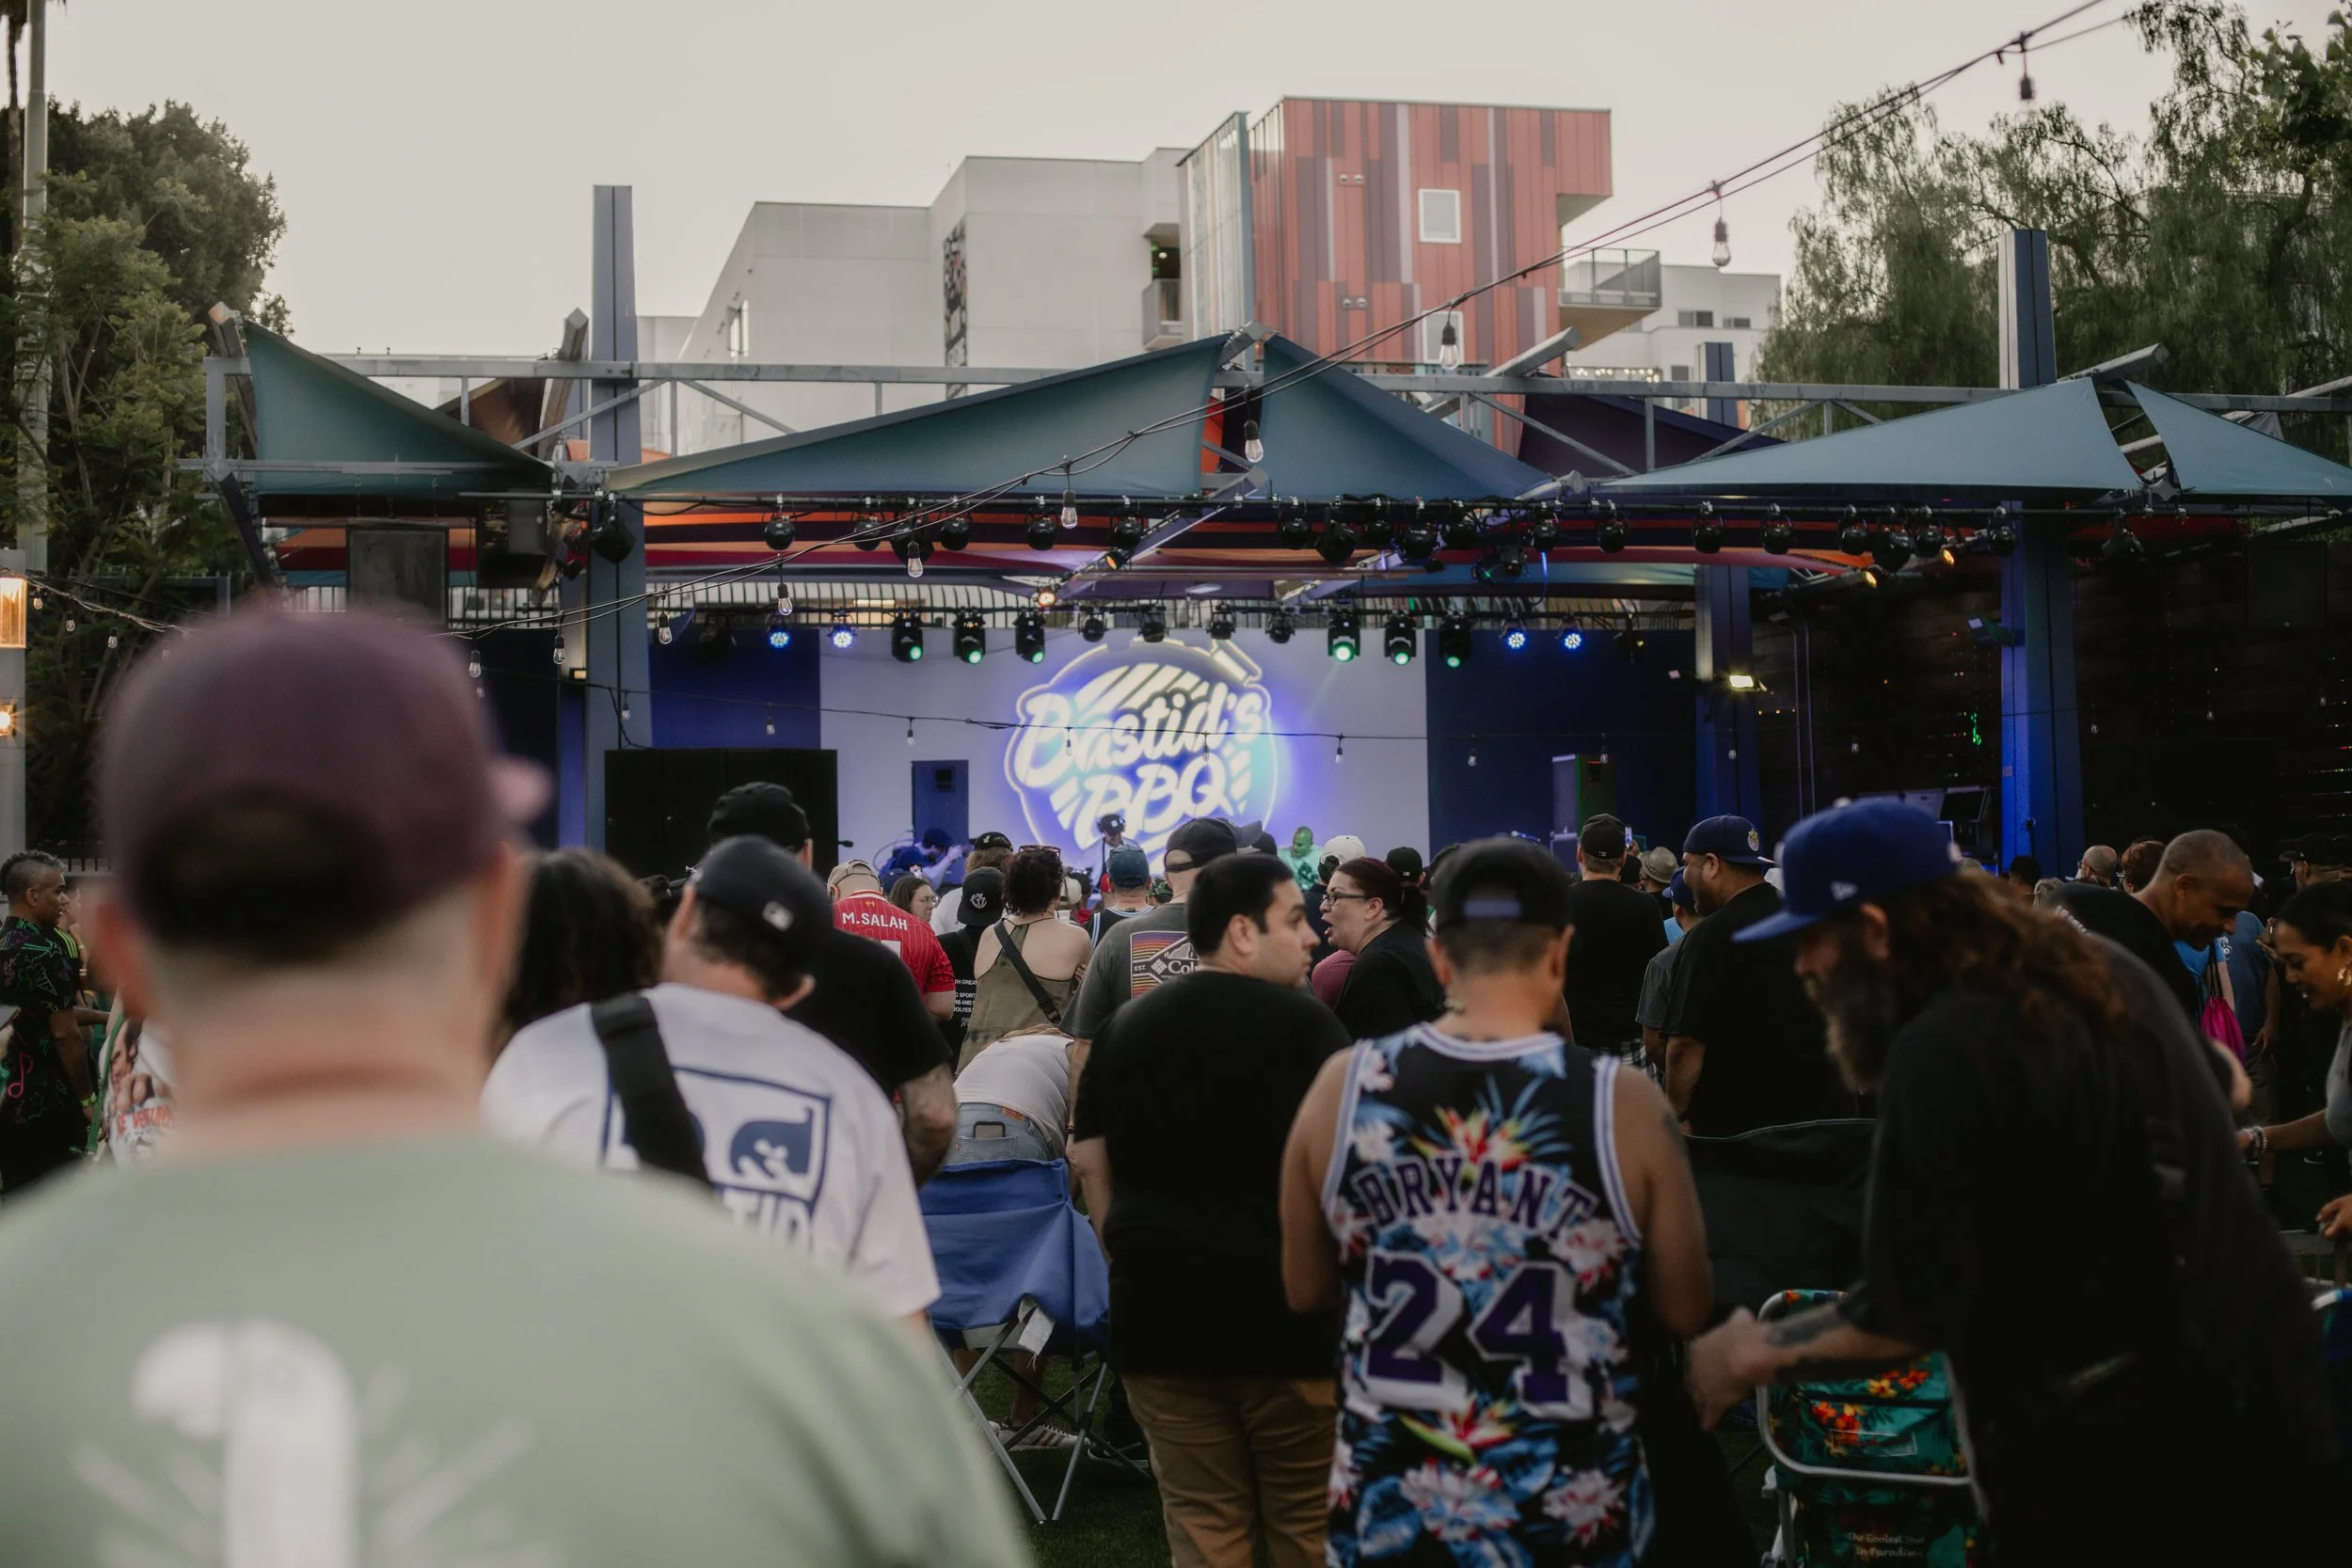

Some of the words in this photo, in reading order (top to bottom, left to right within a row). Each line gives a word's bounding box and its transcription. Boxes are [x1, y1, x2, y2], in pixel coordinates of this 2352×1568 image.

[1014, 681, 1263, 787] Bastid's
[1073, 752, 1234, 850] BBQ
[842, 911, 908, 931] M.SALAH
[1352, 1156, 1597, 1237] BRYANT
[1364, 1250, 1594, 1418] 24
[1867, 1533, 1902, 1544] Coolest
